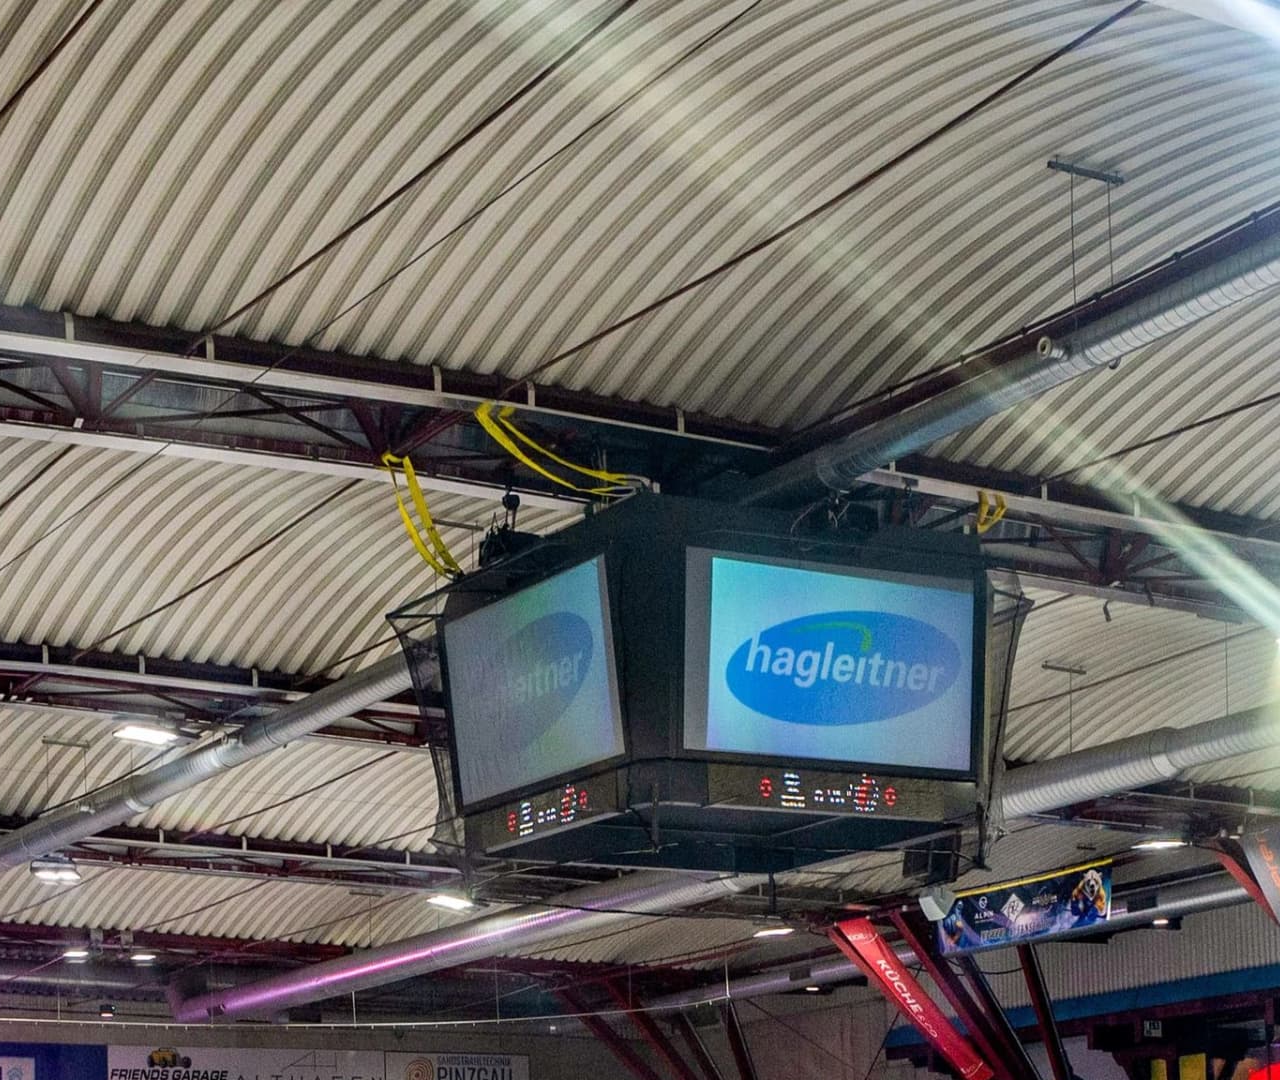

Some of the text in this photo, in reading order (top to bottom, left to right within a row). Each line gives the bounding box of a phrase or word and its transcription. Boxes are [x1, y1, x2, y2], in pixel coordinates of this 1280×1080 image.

[745, 629, 944, 694] hagleitner
[876, 959, 923, 1013] KÜCHE
[110, 1069, 169, 1080] FRIENDS
